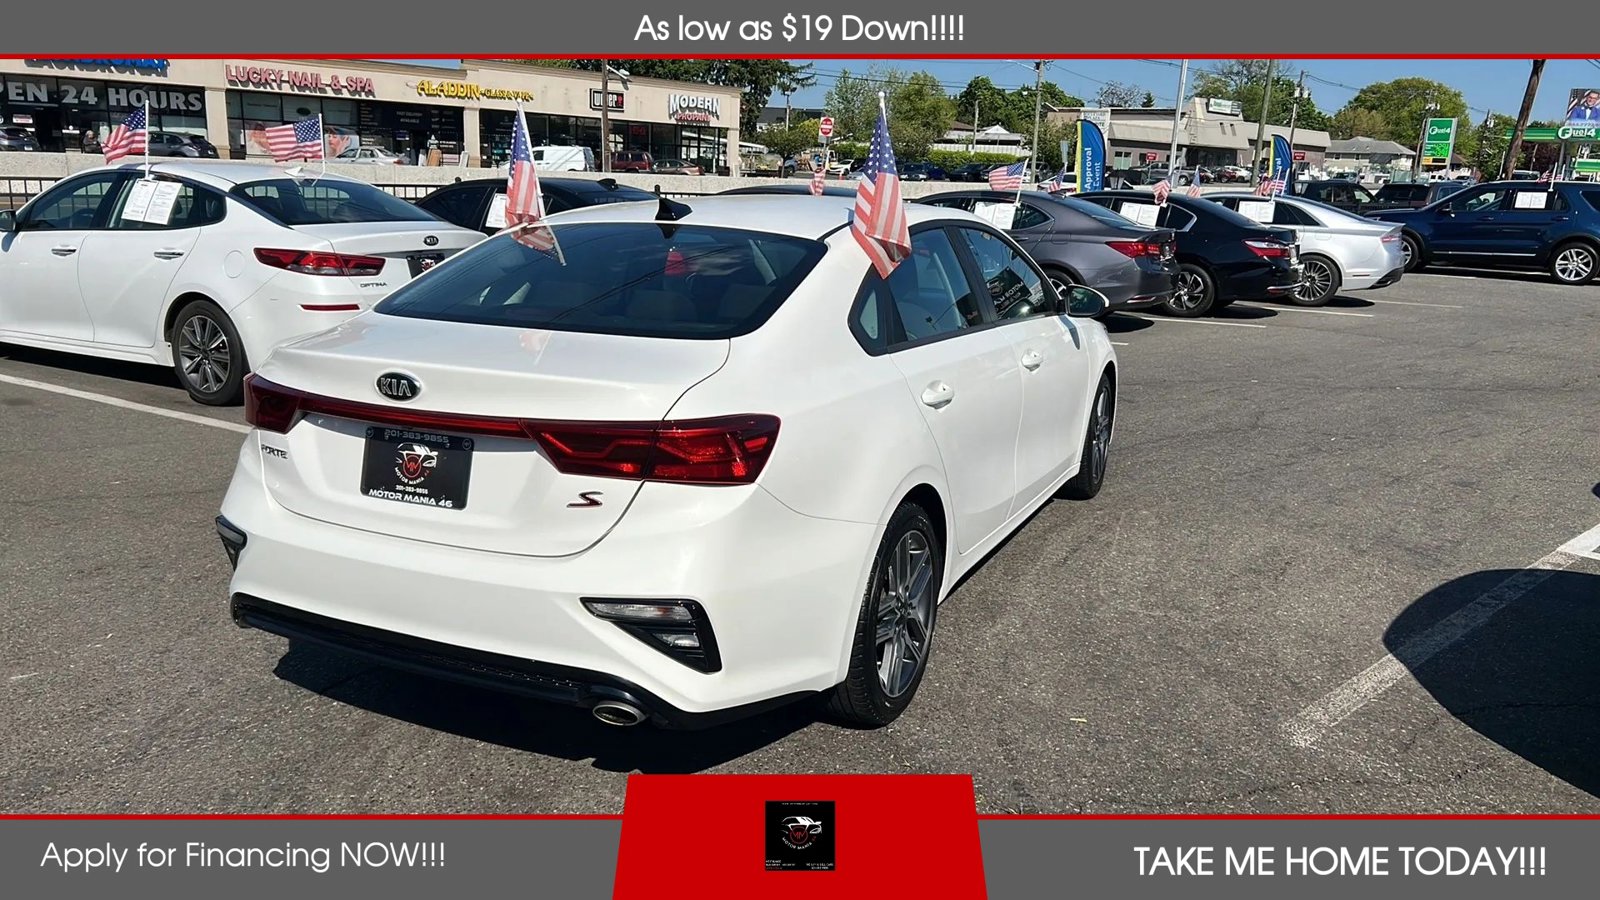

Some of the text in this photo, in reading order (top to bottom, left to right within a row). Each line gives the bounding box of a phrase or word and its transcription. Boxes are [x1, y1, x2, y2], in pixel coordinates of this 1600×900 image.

[225, 64, 375, 93] LUCKY NAIL & SPA
[60, 84, 98, 105] 24
[107, 87, 203, 111] HOURS
[416, 80, 480, 99] ALADDIN
[671, 93, 721, 116] MODERN
[1084, 147, 1093, 190] Approval
[1093, 162, 1101, 187] Event
[380, 377, 412, 397] KIA
[261, 444, 288, 460] FORTE
[368, 488, 454, 508] MOTOR MANIA 46
[566, 491, 604, 508] S
